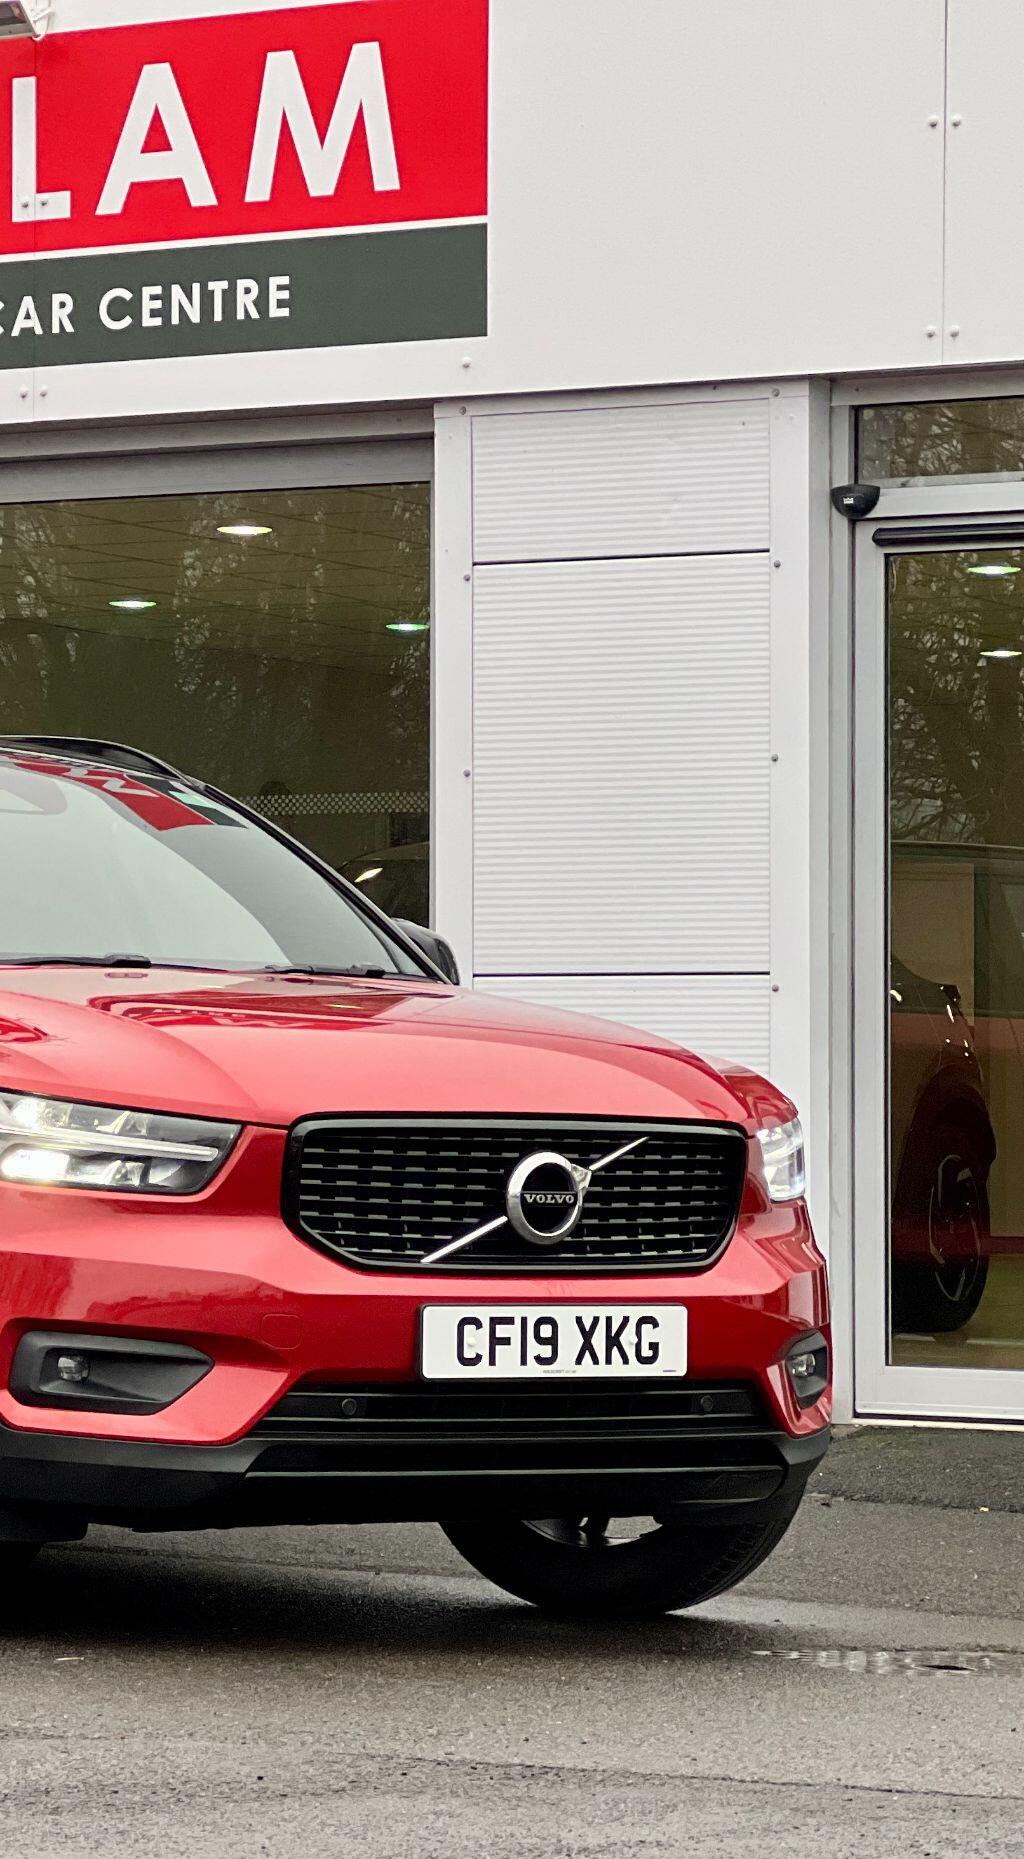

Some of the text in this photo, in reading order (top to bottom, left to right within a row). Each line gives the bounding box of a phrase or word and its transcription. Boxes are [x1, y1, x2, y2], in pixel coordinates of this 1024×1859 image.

[98, 275, 291, 330] CENTRE
[523, 1193, 575, 1204] VOLVO
[456, 1315, 660, 1367] CF19 XKG
